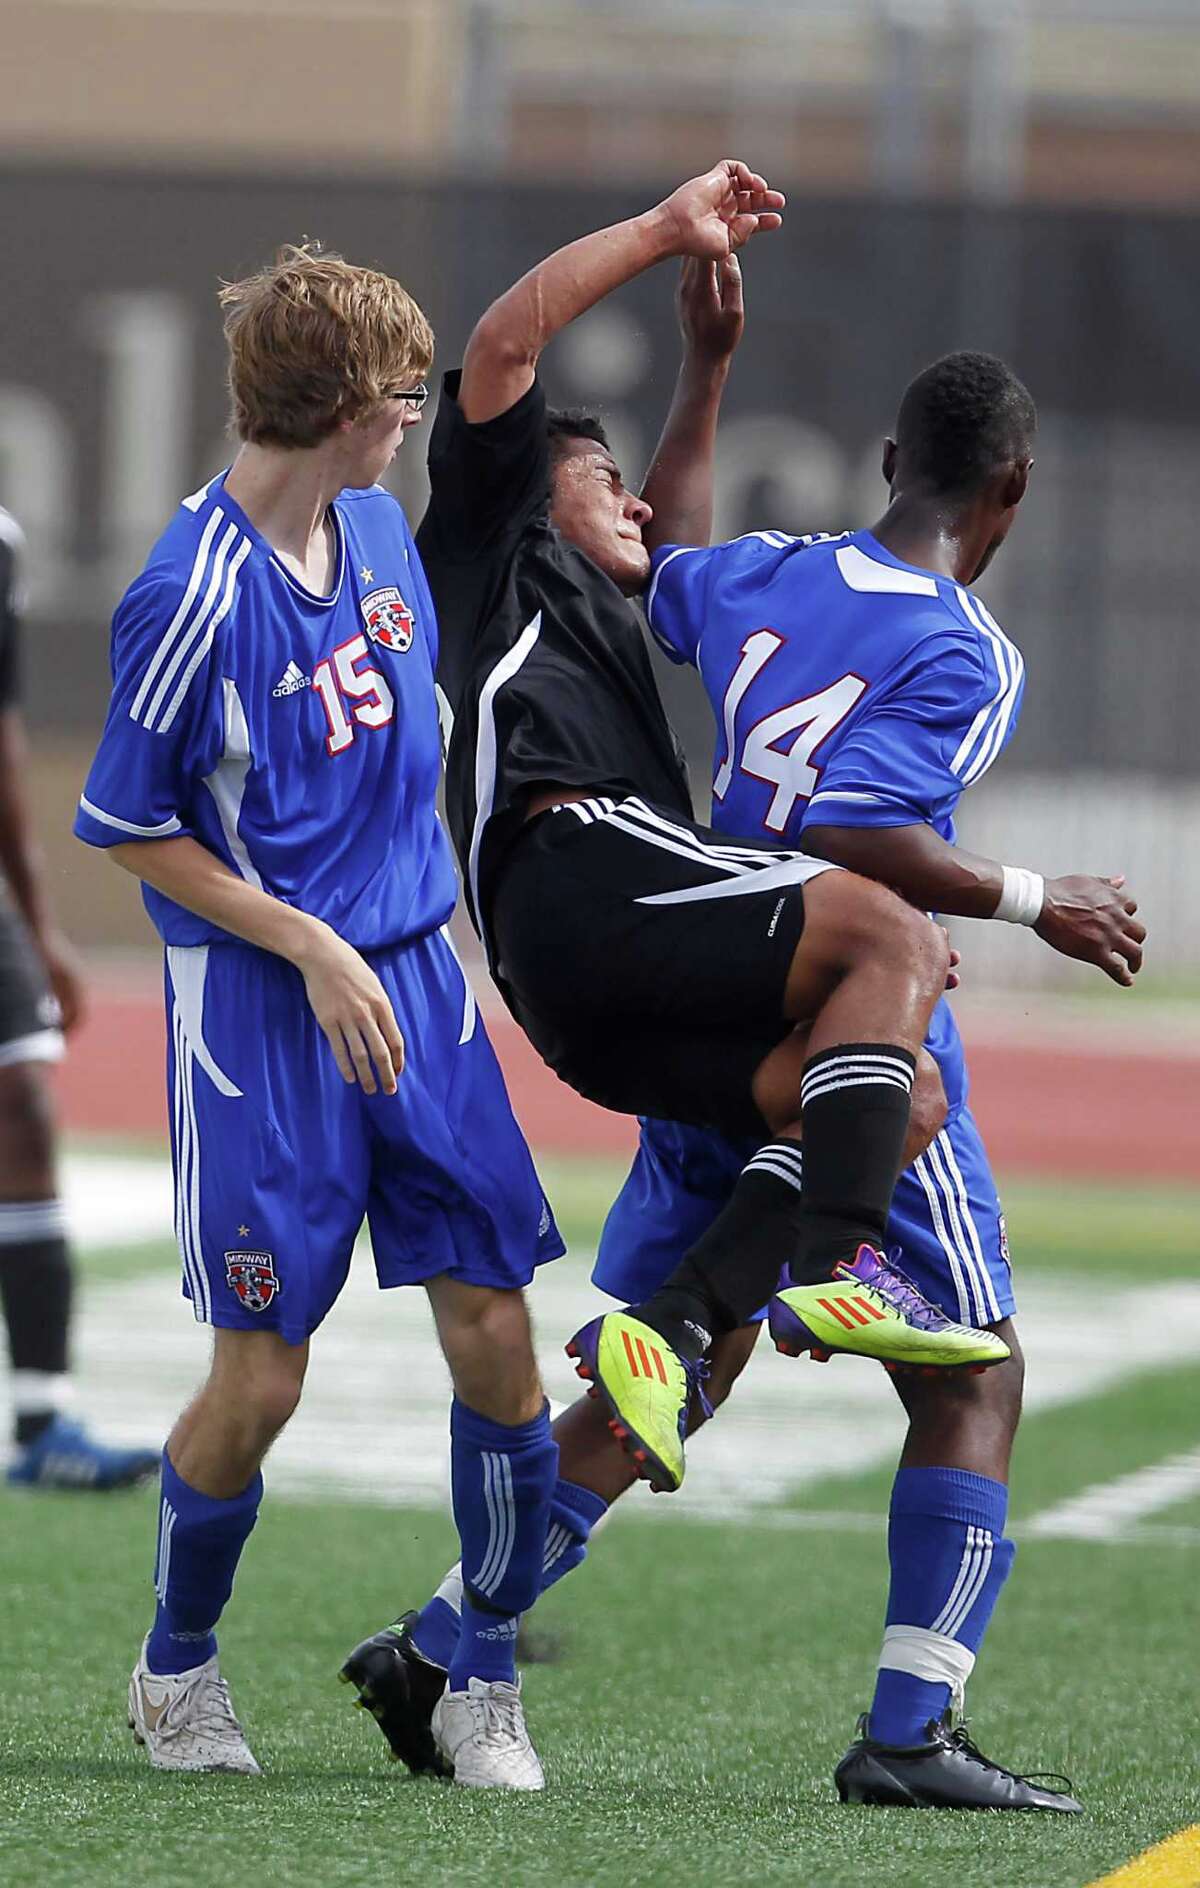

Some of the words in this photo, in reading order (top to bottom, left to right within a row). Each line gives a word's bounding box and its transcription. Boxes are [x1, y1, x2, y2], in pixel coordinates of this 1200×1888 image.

[272, 676, 311, 697] adidas
[313, 633, 394, 756] 15
[711, 626, 868, 834] 14
[228, 1254, 268, 1266] MIDWAY
[475, 1629, 517, 1640] adida
